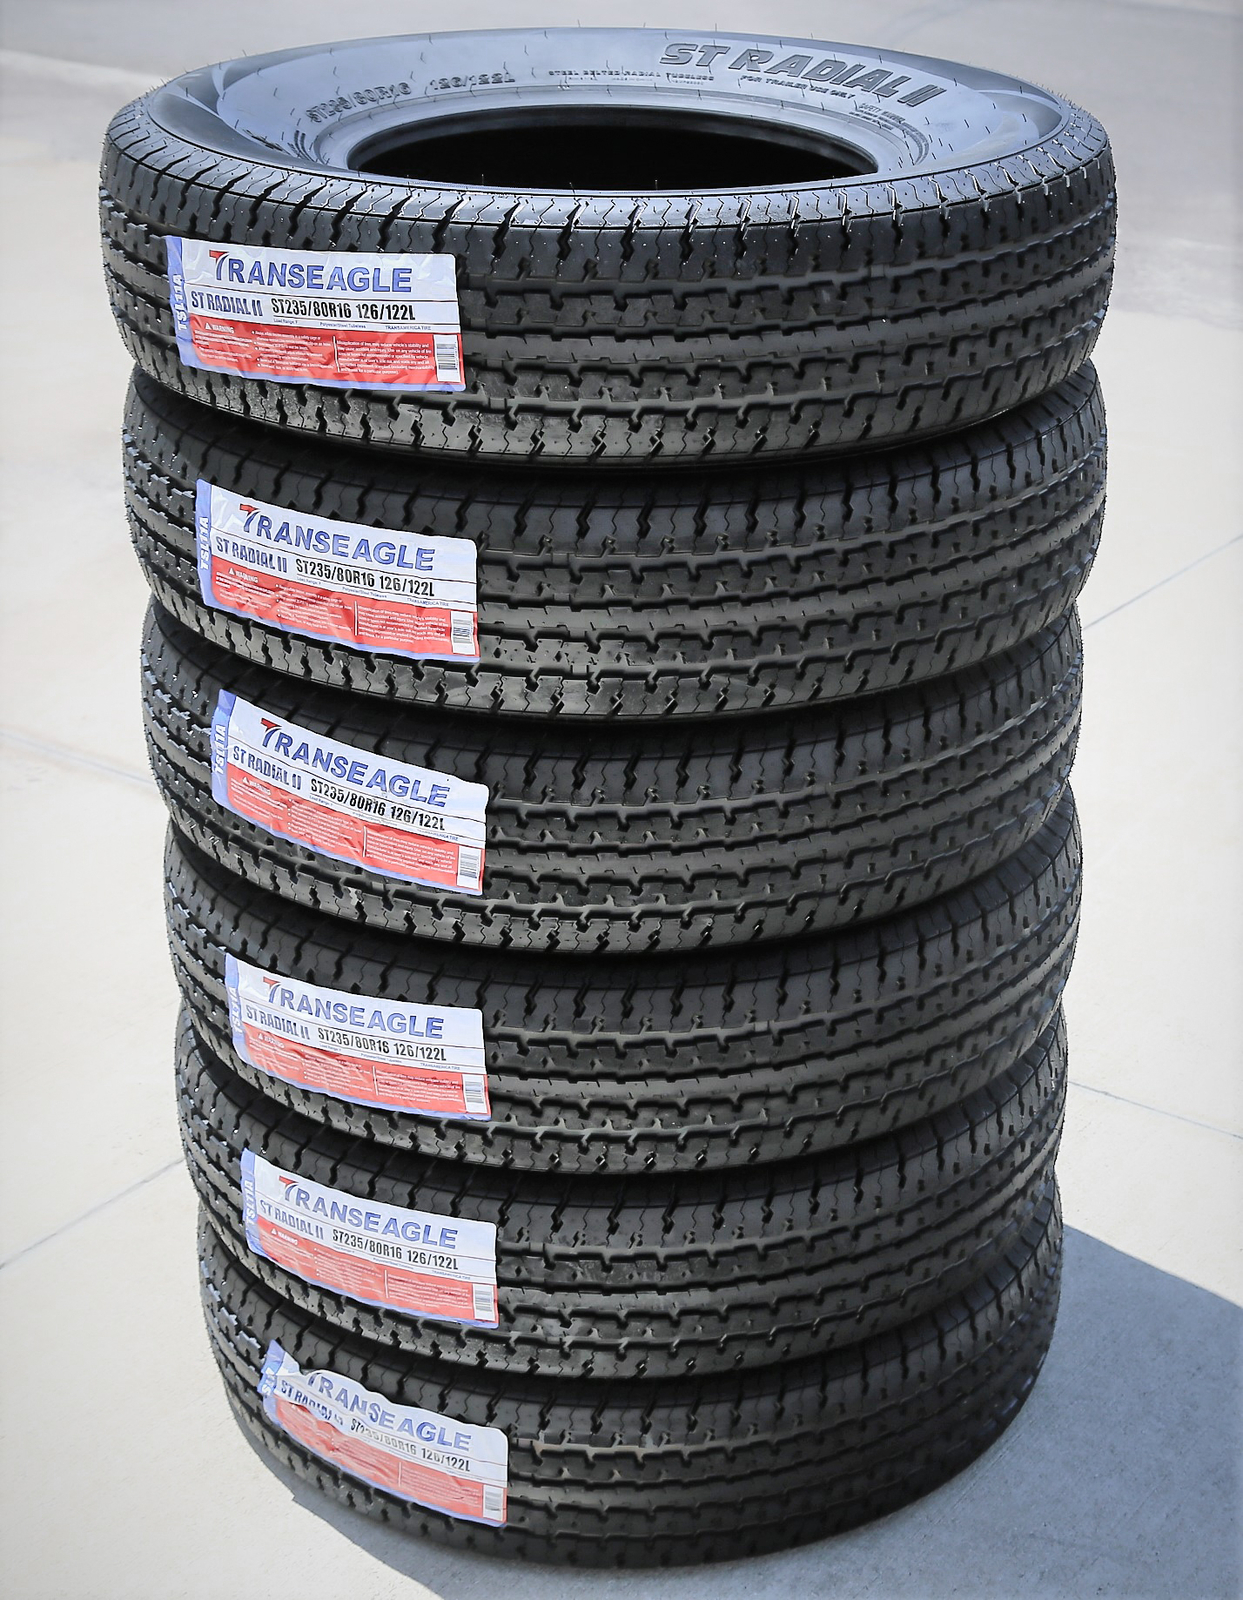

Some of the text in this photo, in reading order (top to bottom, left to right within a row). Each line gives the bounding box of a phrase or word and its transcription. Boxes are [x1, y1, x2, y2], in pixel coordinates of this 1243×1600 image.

[659, 42, 731, 67] ST
[728, 48, 912, 98] RADIAL
[209, 250, 412, 293] TRANSEAGLE
[191, 290, 206, 308] ST
[207, 292, 251, 315] RADIAL
[271, 298, 416, 321] ST235/80R16 126/122L
[215, 536, 231, 554] ST
[232, 540, 277, 571] RADIAL
[240, 504, 436, 571] TRANSEAGLE
[296, 558, 436, 597] ST235/80R16 126/122L
[232, 746, 247, 764] ST
[248, 751, 290, 786] RADIAL
[261, 718, 450, 808] TRANSEAGLE
[310, 778, 386, 816] ST235/80R16
[390, 804, 446, 831] 126/122L
[246, 1005, 259, 1022] ST
[260, 1010, 299, 1038] RADIAL
[263, 976, 444, 1040] TRANSEAGLE
[318, 1028, 389, 1054] ST235/80R16
[393, 1043, 447, 1062] 126/122L
[260, 1200, 273, 1216] ST
[274, 1207, 314, 1236] RADIAL
[279, 1176, 458, 1250] TRANSEAGLE
[332, 1229, 402, 1260] ST235/80R16
[407, 1250, 458, 1270] 126/122L
[281, 1380, 294, 1398] ST
